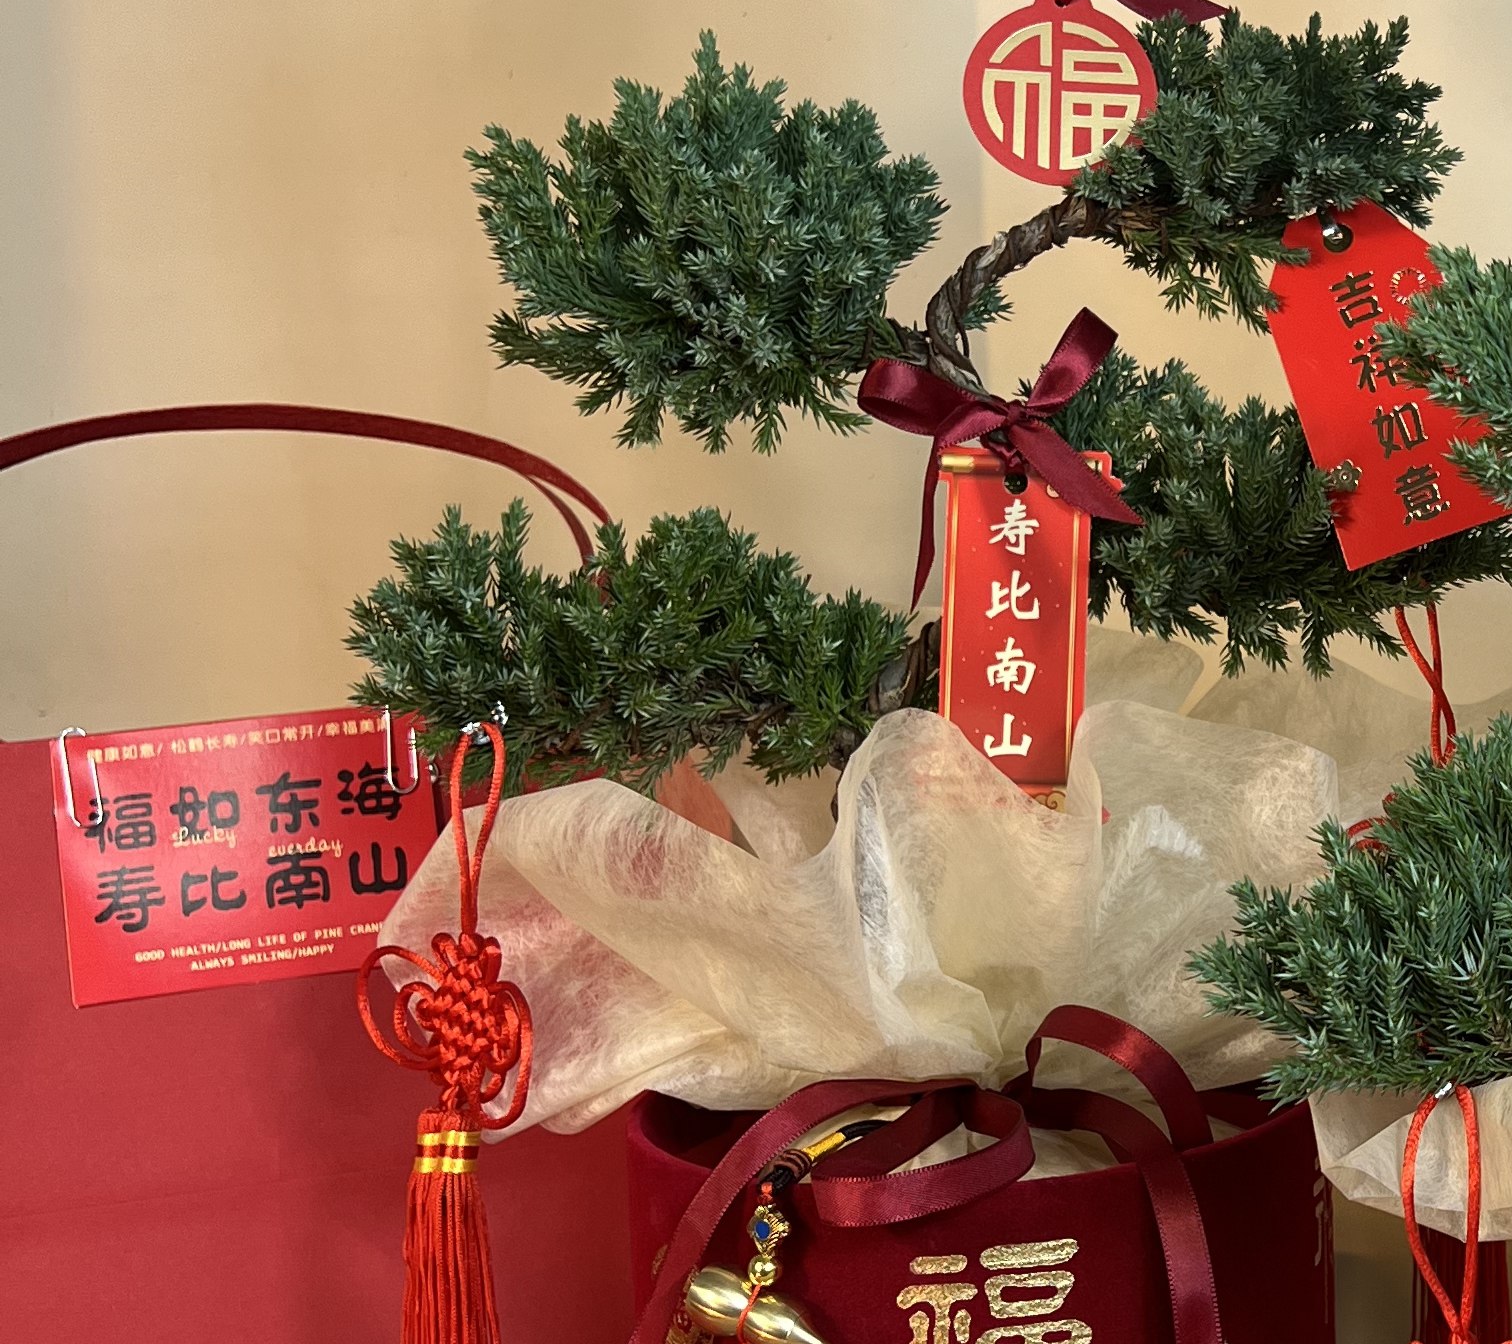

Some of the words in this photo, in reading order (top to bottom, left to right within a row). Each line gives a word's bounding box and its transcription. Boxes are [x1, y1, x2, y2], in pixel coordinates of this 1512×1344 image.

[983, 498, 1040, 757] 寿比南山
[84, 761, 402, 854] 福如东海
[170, 826, 237, 849] Lucky
[94, 842, 408, 933] 寿比南山
[135, 949, 165, 963] GOOD
[171, 937, 251, 958] HEALTH/LONG
[257, 932, 287, 948] LIFE
[293, 931, 307, 942] OF
[314, 926, 343, 940] PINE
[190, 956, 235, 971] ALWAYS
[241, 943, 334, 964] SMILING/HAPPY
